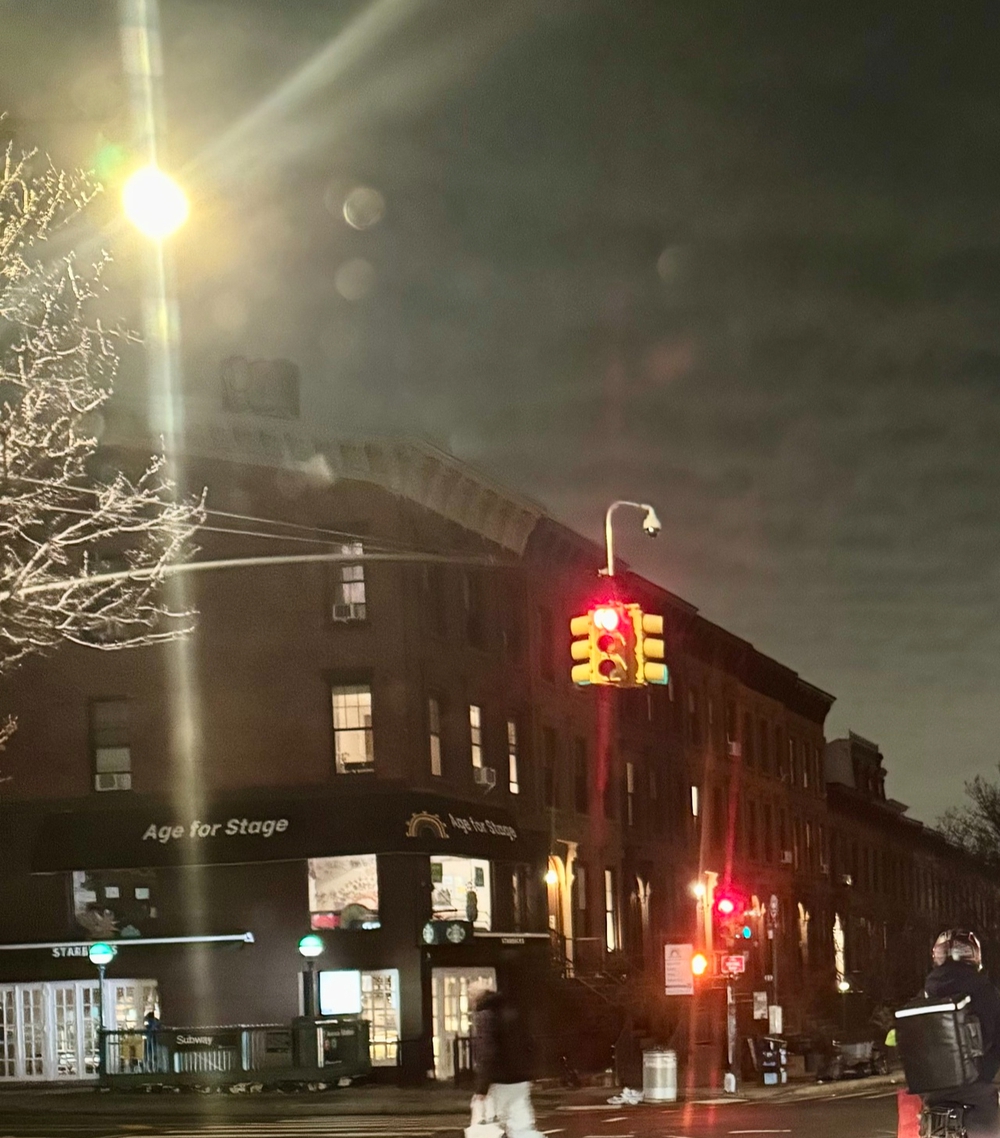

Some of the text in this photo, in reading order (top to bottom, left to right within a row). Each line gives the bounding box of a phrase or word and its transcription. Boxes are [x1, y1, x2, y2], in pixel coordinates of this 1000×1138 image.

[142, 817, 290, 844] Age for Stage
[448, 812, 517, 841] Age for Stage
[52, 944, 118, 958] STARBS
[176, 1034, 213, 1047] Subway
